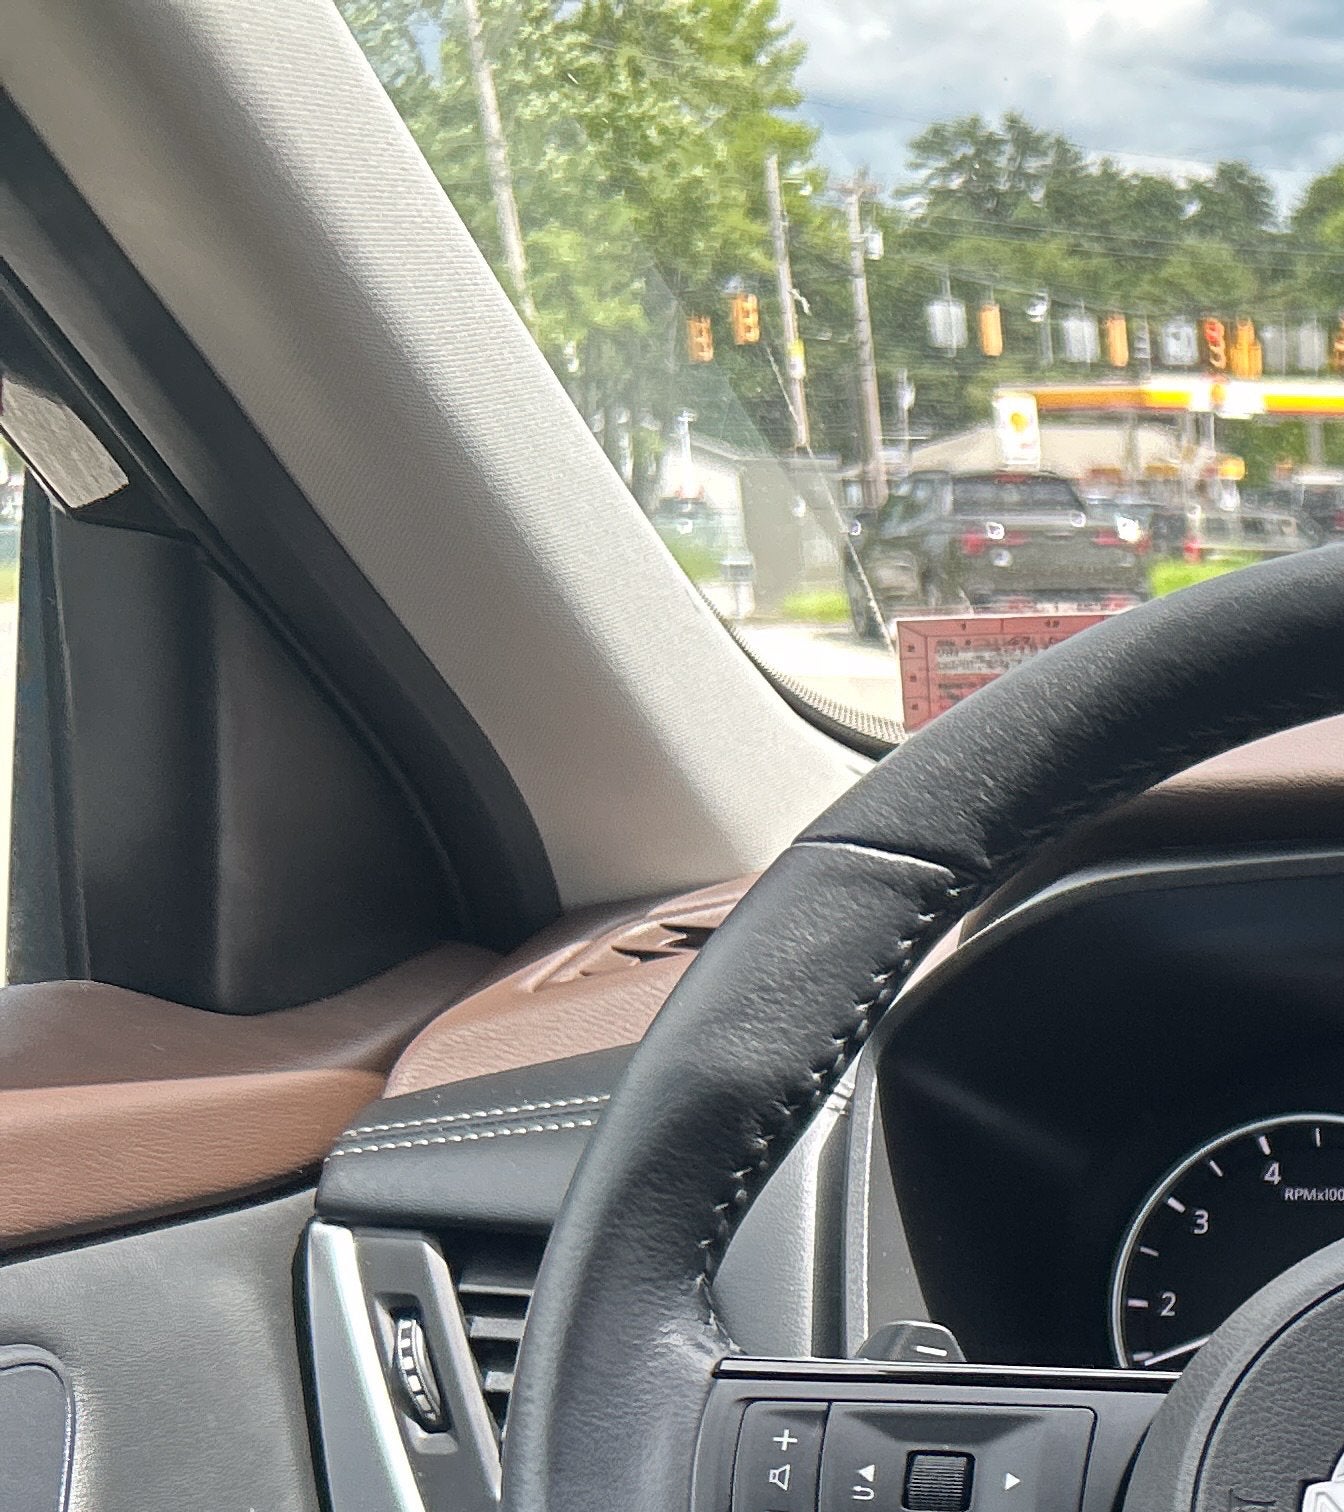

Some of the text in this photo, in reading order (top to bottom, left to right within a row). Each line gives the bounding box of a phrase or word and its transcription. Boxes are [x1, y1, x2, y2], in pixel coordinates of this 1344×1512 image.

[1263, 1162, 1282, 1186] 4
[1192, 1209, 1209, 1236] 3
[1161, 1292, 1176, 1317] 2
